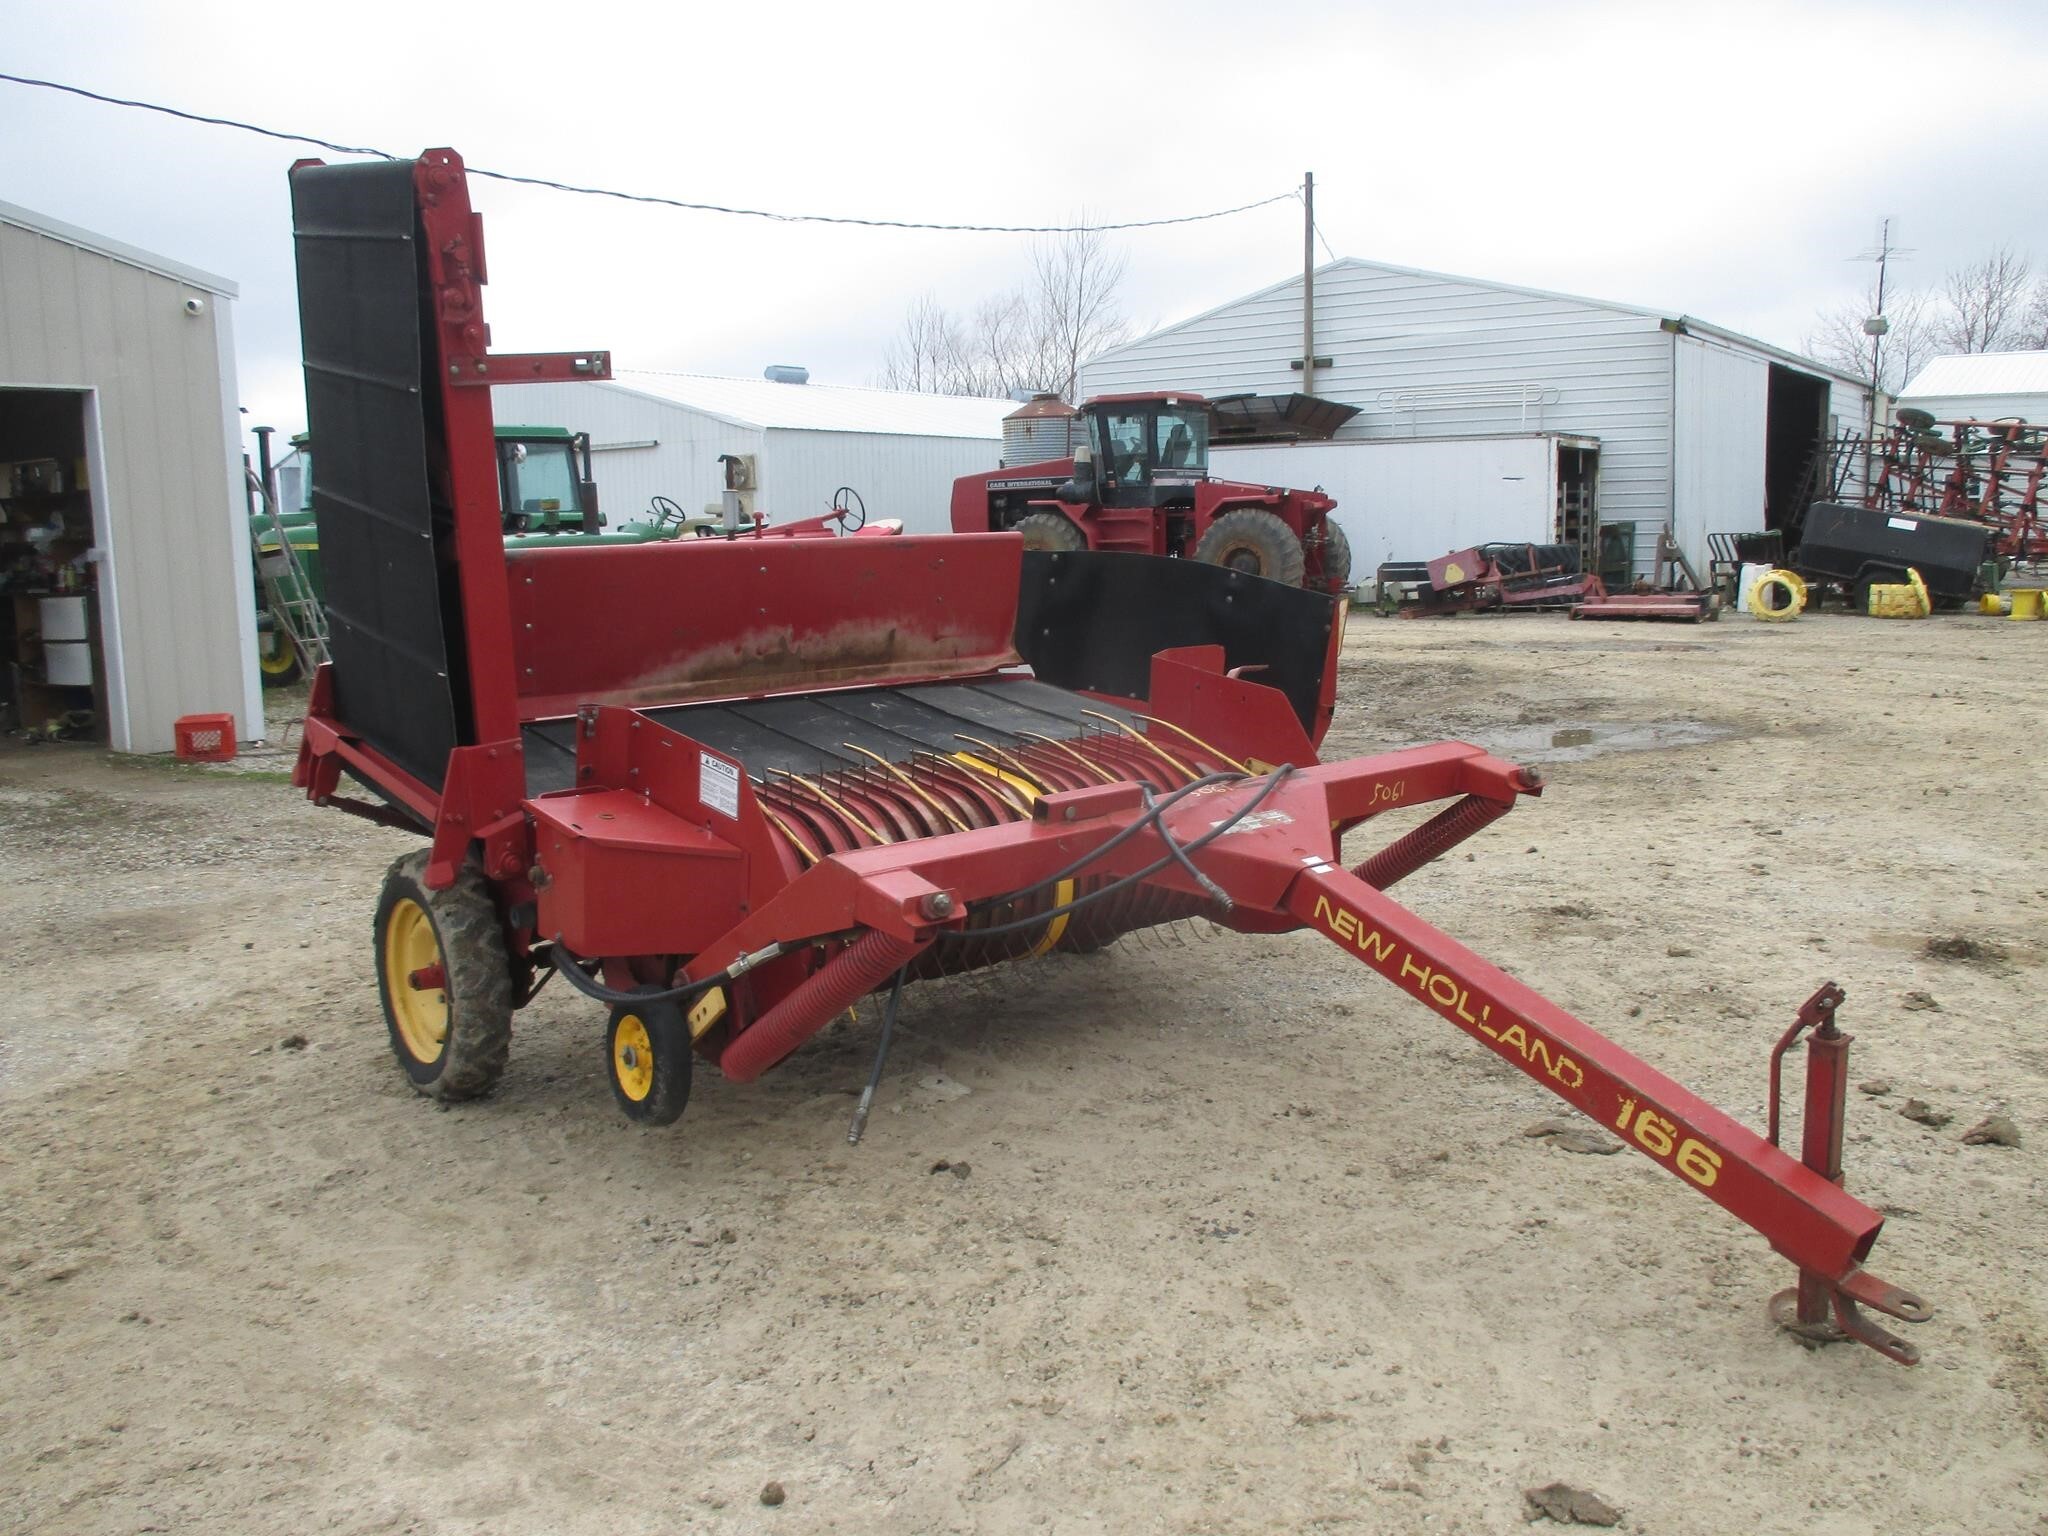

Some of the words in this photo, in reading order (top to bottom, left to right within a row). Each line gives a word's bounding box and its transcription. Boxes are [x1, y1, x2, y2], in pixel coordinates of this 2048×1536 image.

[712, 760, 734, 776] CAUTION
[1369, 781, 1405, 806] 5061
[1314, 895, 1396, 962] NEW
[1401, 953, 1584, 1089] HOLLAND
[1615, 1095, 1722, 1187] 166
